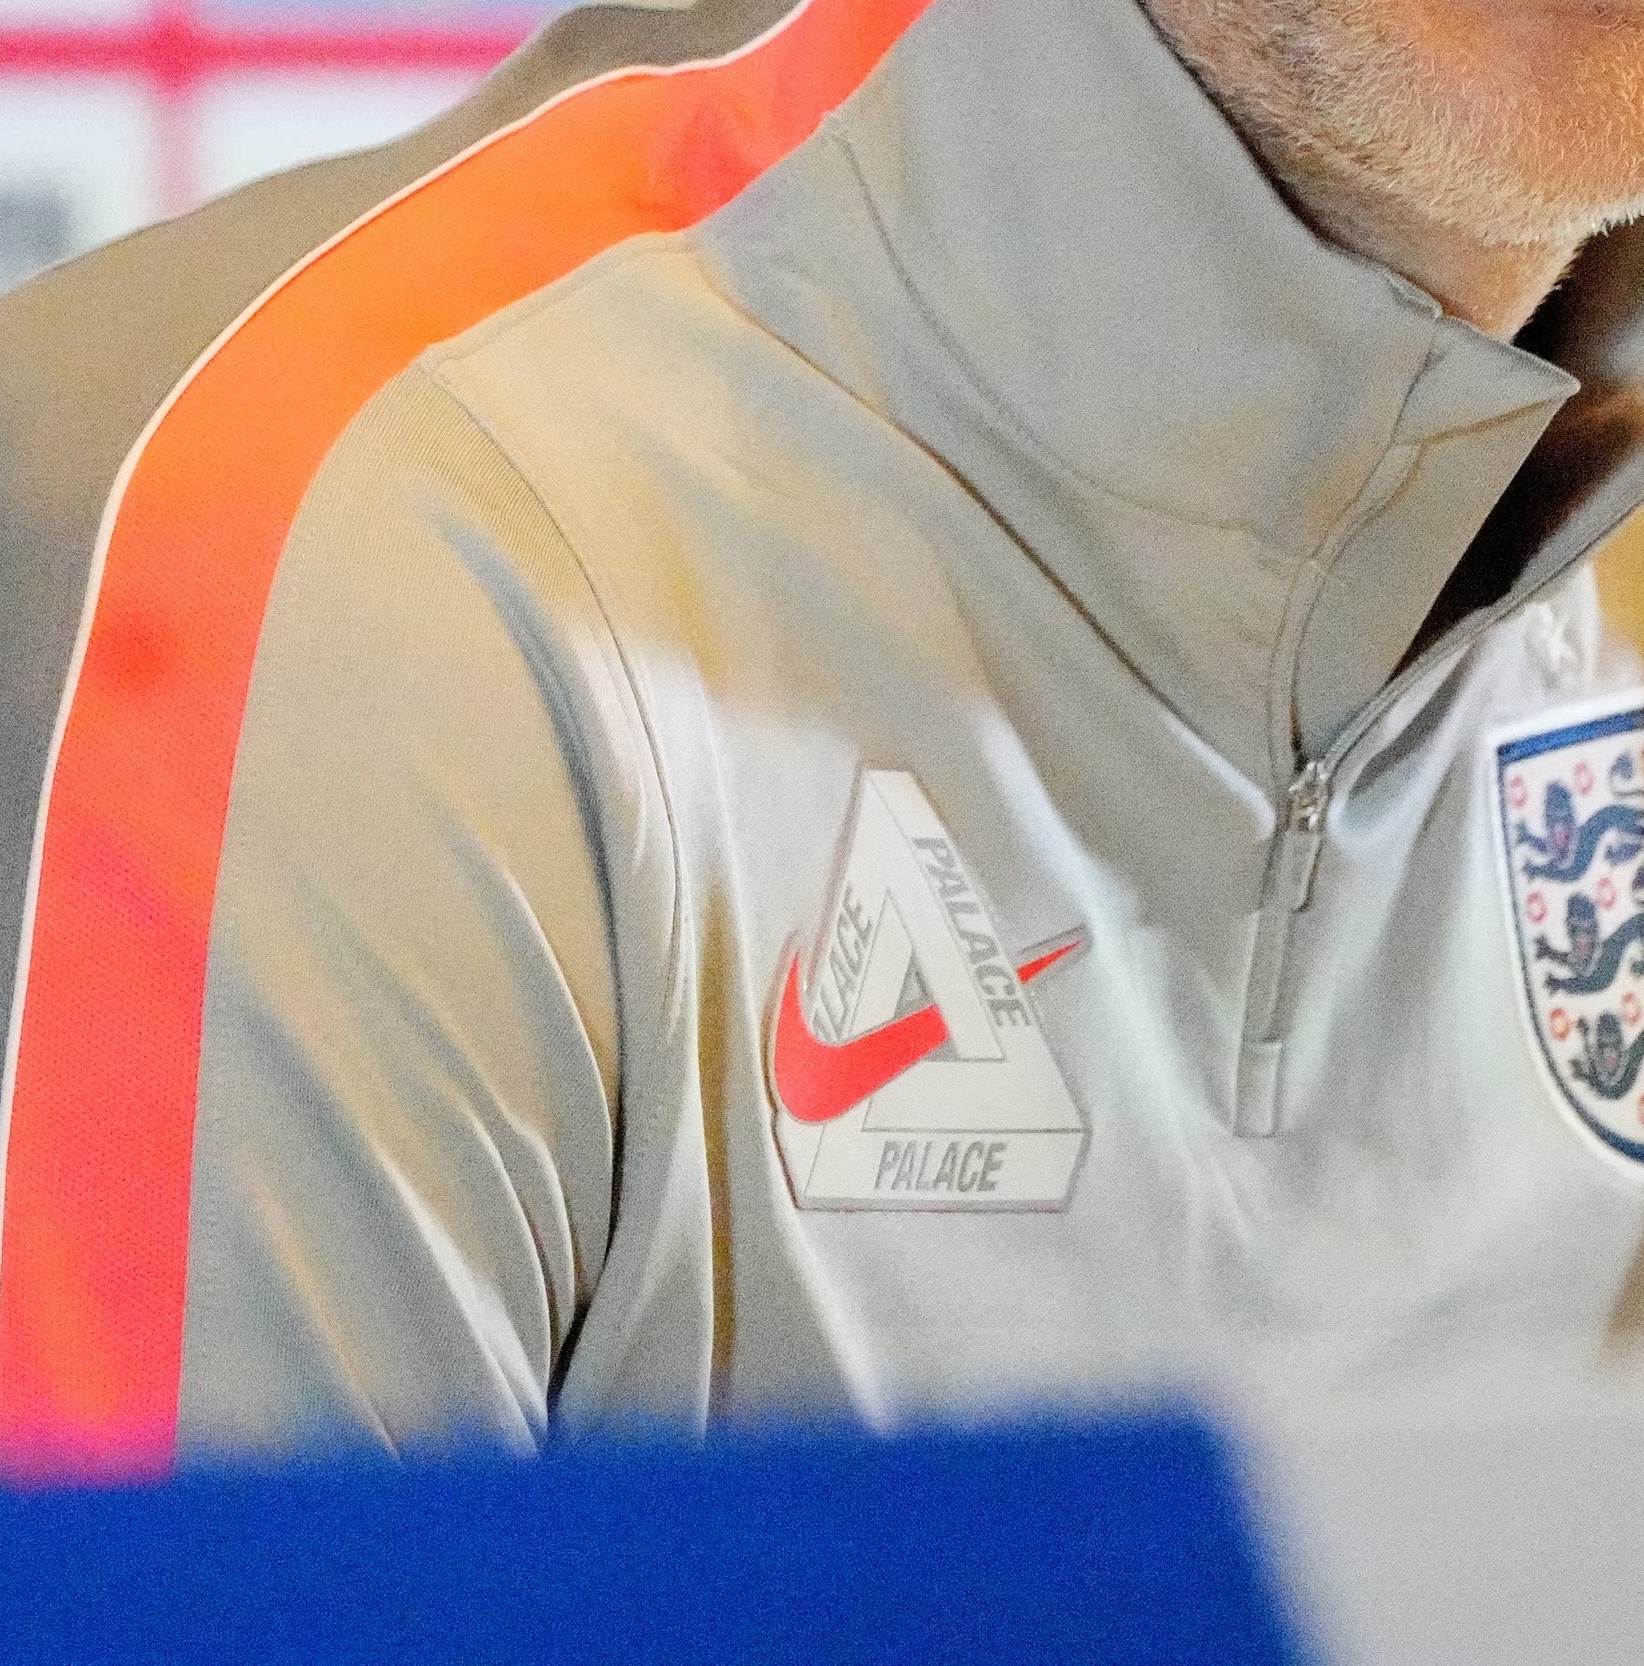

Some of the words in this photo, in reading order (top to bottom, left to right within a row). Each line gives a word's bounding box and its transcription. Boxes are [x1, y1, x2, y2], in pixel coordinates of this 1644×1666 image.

[812, 882, 872, 1043] LACE
[912, 835, 1031, 1029] PALACE
[874, 1140, 1008, 1194] PALACE
